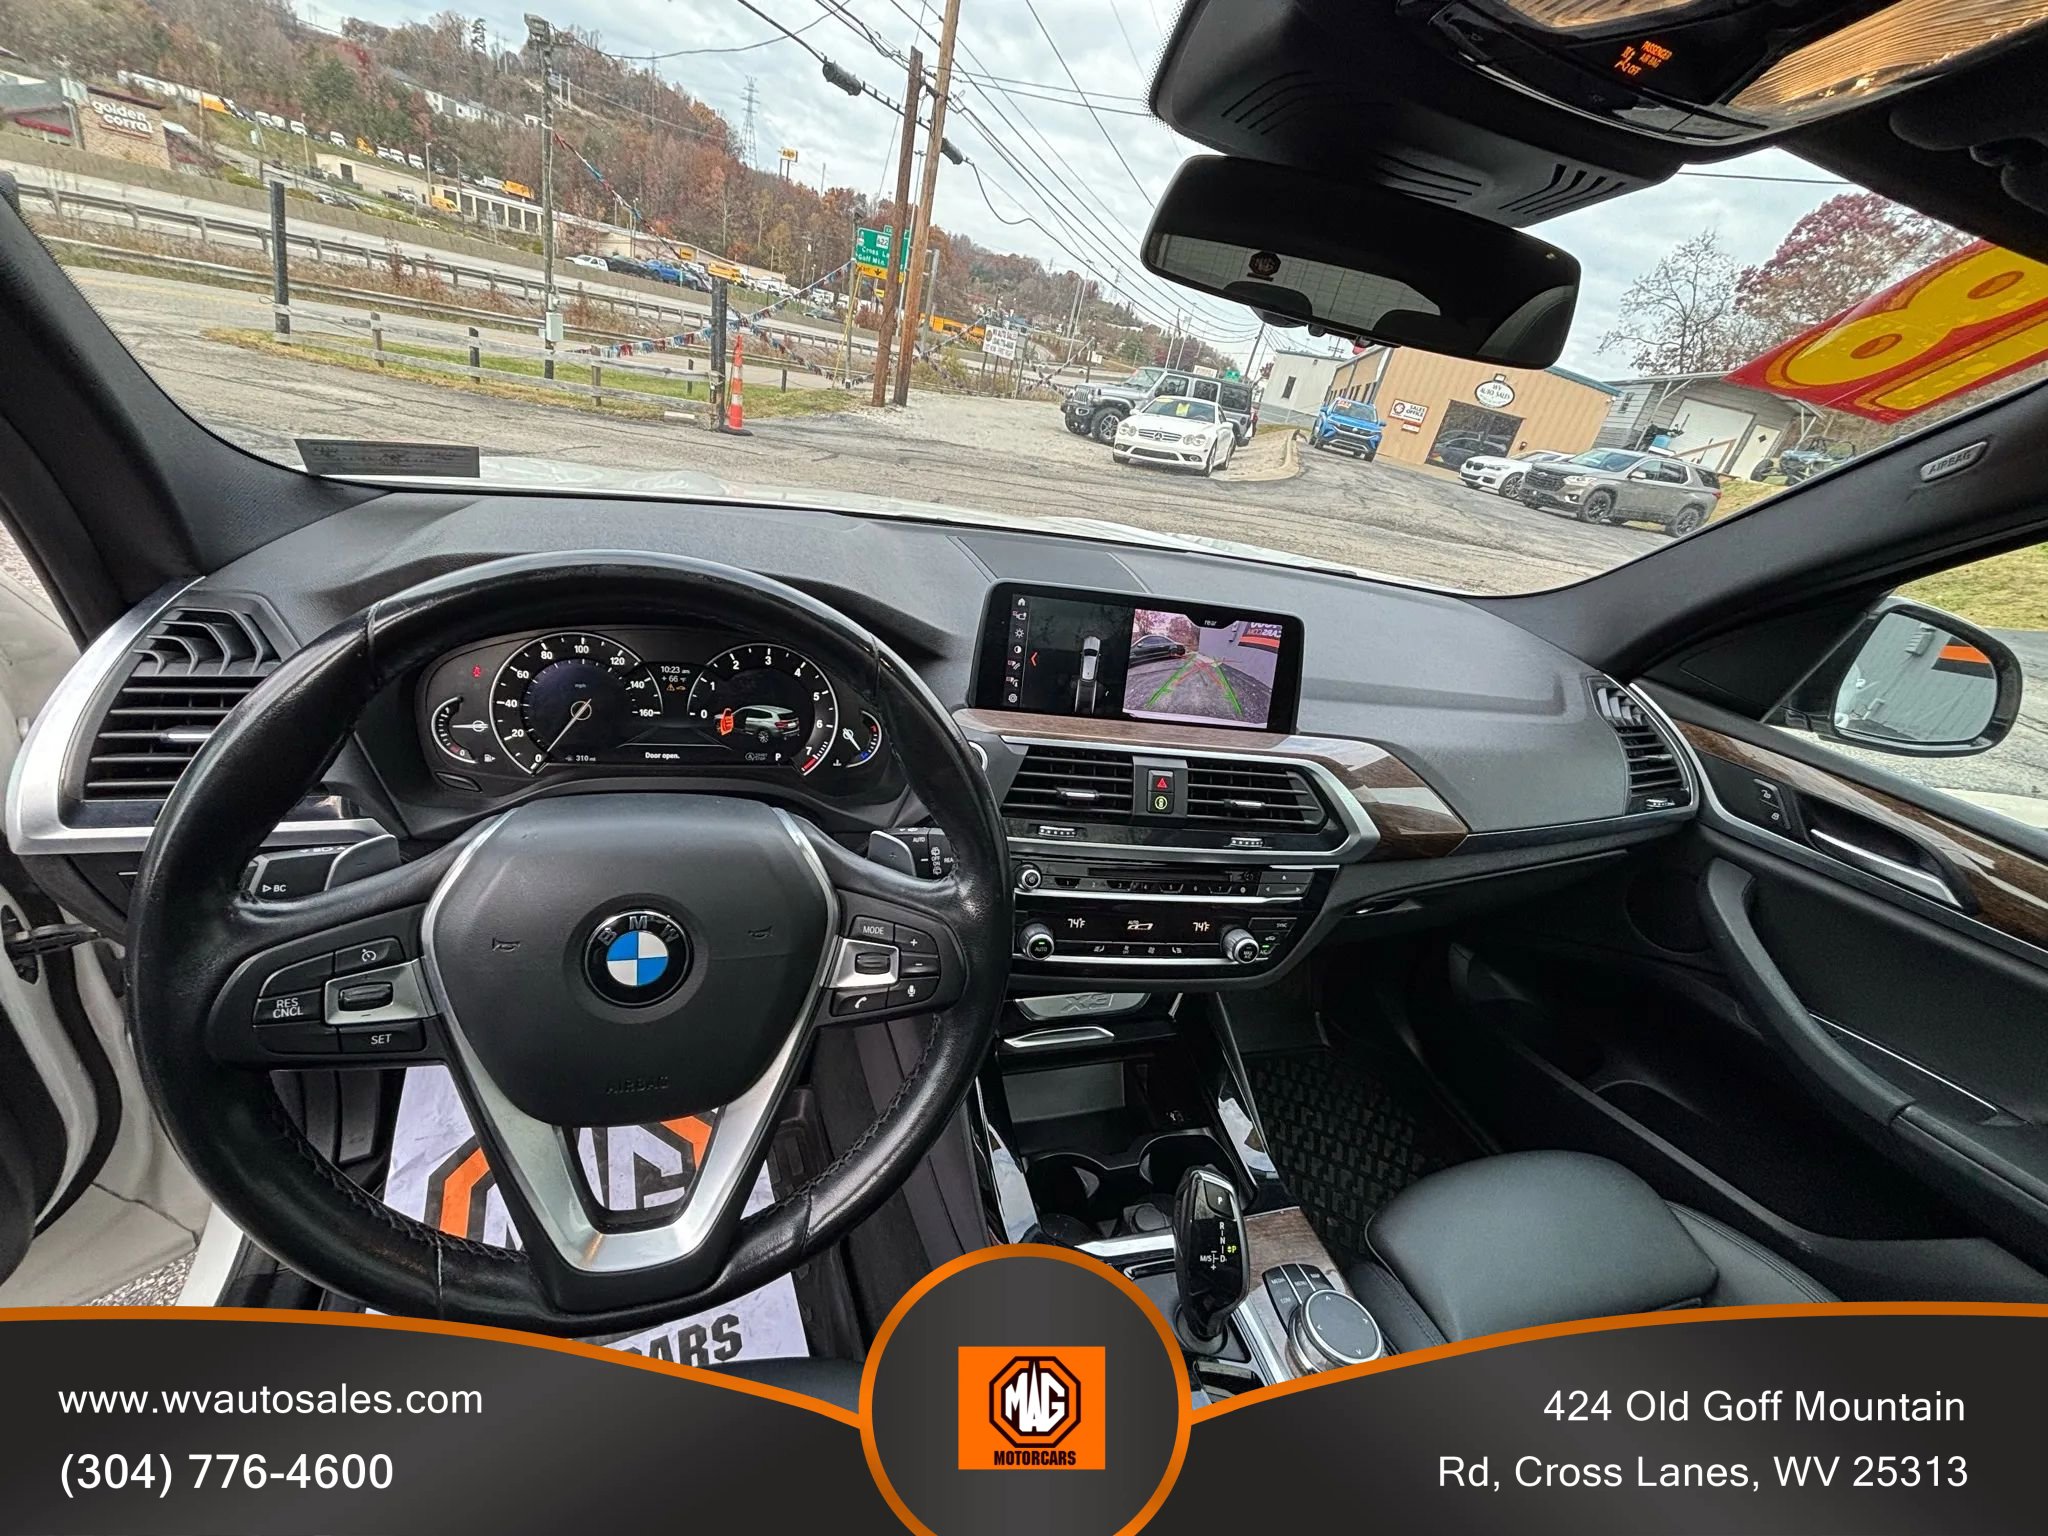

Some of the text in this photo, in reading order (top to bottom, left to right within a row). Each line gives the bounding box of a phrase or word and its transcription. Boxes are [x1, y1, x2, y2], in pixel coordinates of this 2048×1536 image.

[91, 101, 146, 120] golden
[103, 113, 153, 133] corral
[1406, 408, 1424, 417] OFFICE
[1410, 404, 1425, 413] SALES
[1928, 449, 1972, 475] AIRBAG
[574, 645, 589, 654] 100
[541, 651, 553, 660] 80
[610, 656, 625, 665] 120
[765, 656, 772, 665] 3
[661, 665, 681, 674] 10:23
[733, 661, 740, 670] 2
[517, 670, 529, 679] 60
[794, 668, 801, 677] 4
[669, 675, 679, 683] 66
[630, 680, 645, 689] 140
[710, 681, 716, 691] 1
[813, 692, 820, 701] 5
[505, 699, 518, 708] 40
[639, 709, 654, 717] 160
[701, 710, 708, 719] 0
[817, 720, 823, 729] 6
[511, 729, 524, 738] 20
[806, 746, 812, 755] 7
[535, 754, 542, 763] 0
[662, 752, 680, 761] open.
[775, 752, 782, 761] P
[273, 884, 287, 892] BC
[597, 915, 679, 946] BMW
[862, 925, 885, 935] MODE
[276, 997, 299, 1009] RES
[272, 1007, 304, 1019] CNCL
[371, 1033, 393, 1045] SET
[1217, 1196, 1223, 1205] P
[1219, 1221, 1225, 1230] R
[1219, 1237, 1225, 1245] N
[1200, 1255, 1212, 1263] M/S
